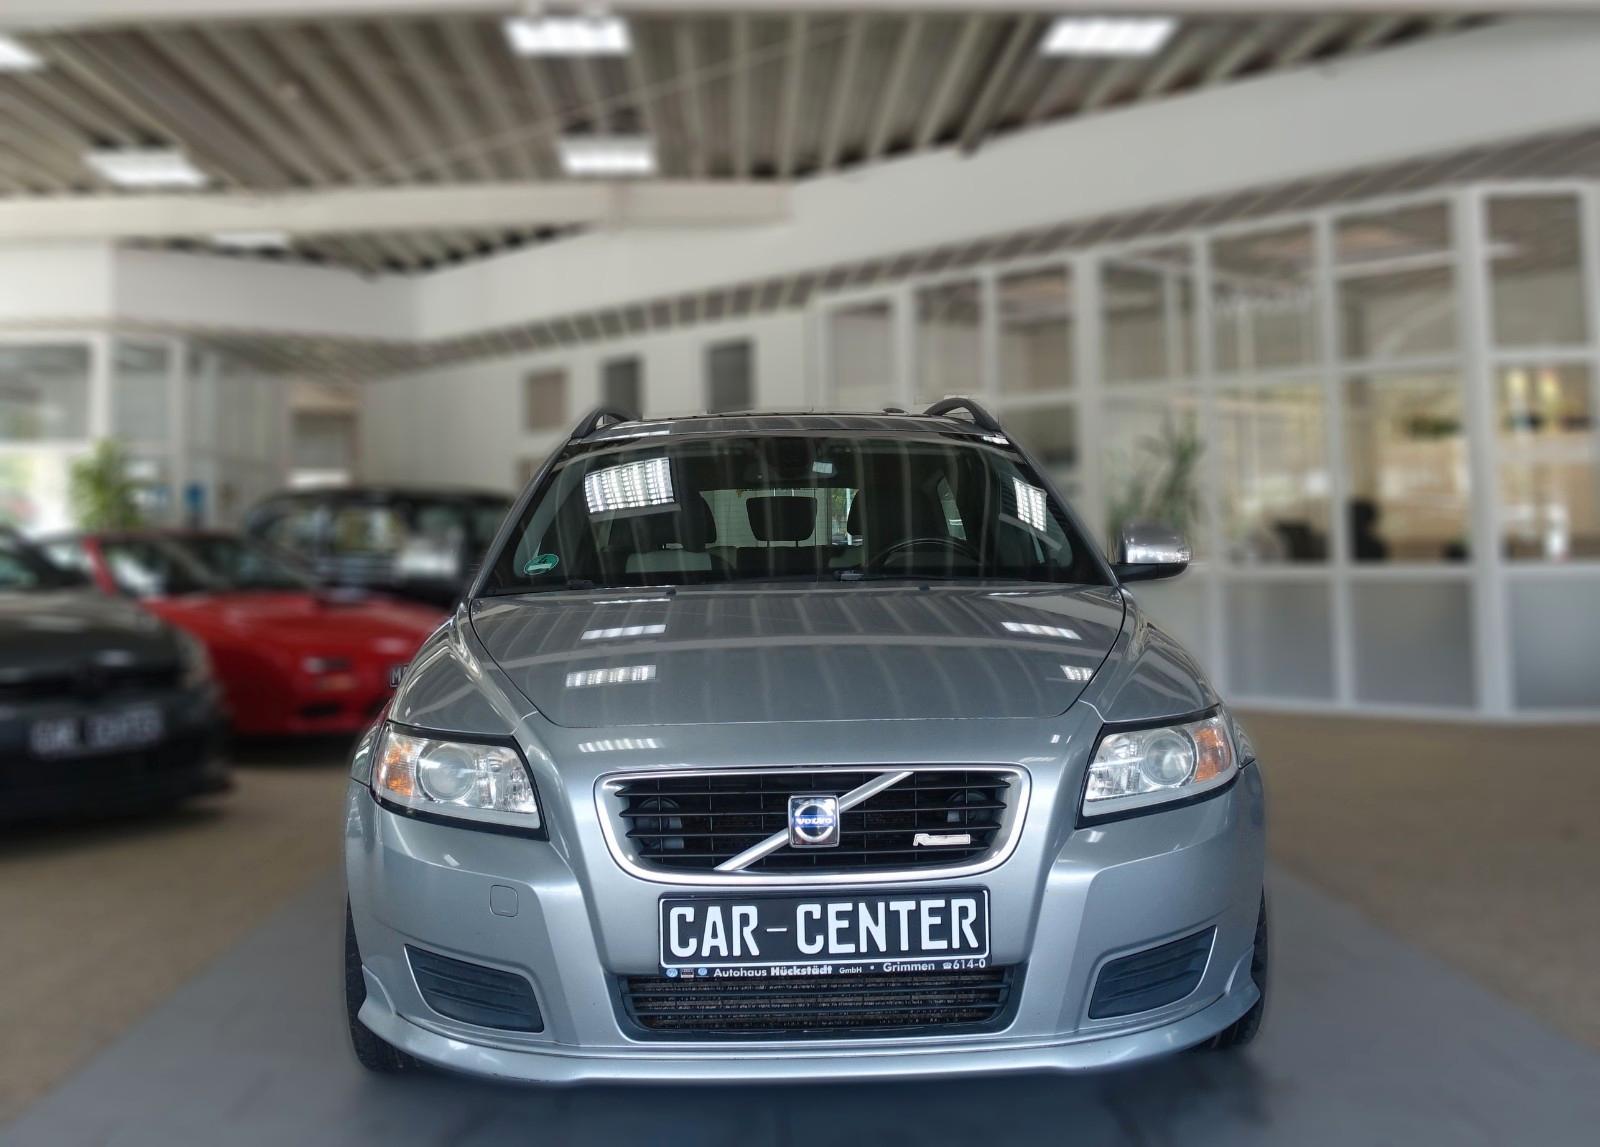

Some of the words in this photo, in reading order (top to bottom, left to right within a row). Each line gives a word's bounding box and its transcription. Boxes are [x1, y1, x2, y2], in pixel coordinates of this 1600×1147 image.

[796, 817, 833, 825] VOLVO
[713, 966, 767, 978] Autohaus
[770, 964, 833, 976] Hückstädt
[839, 966, 862, 975] GmbH
[882, 960, 936, 973] Grimmen
